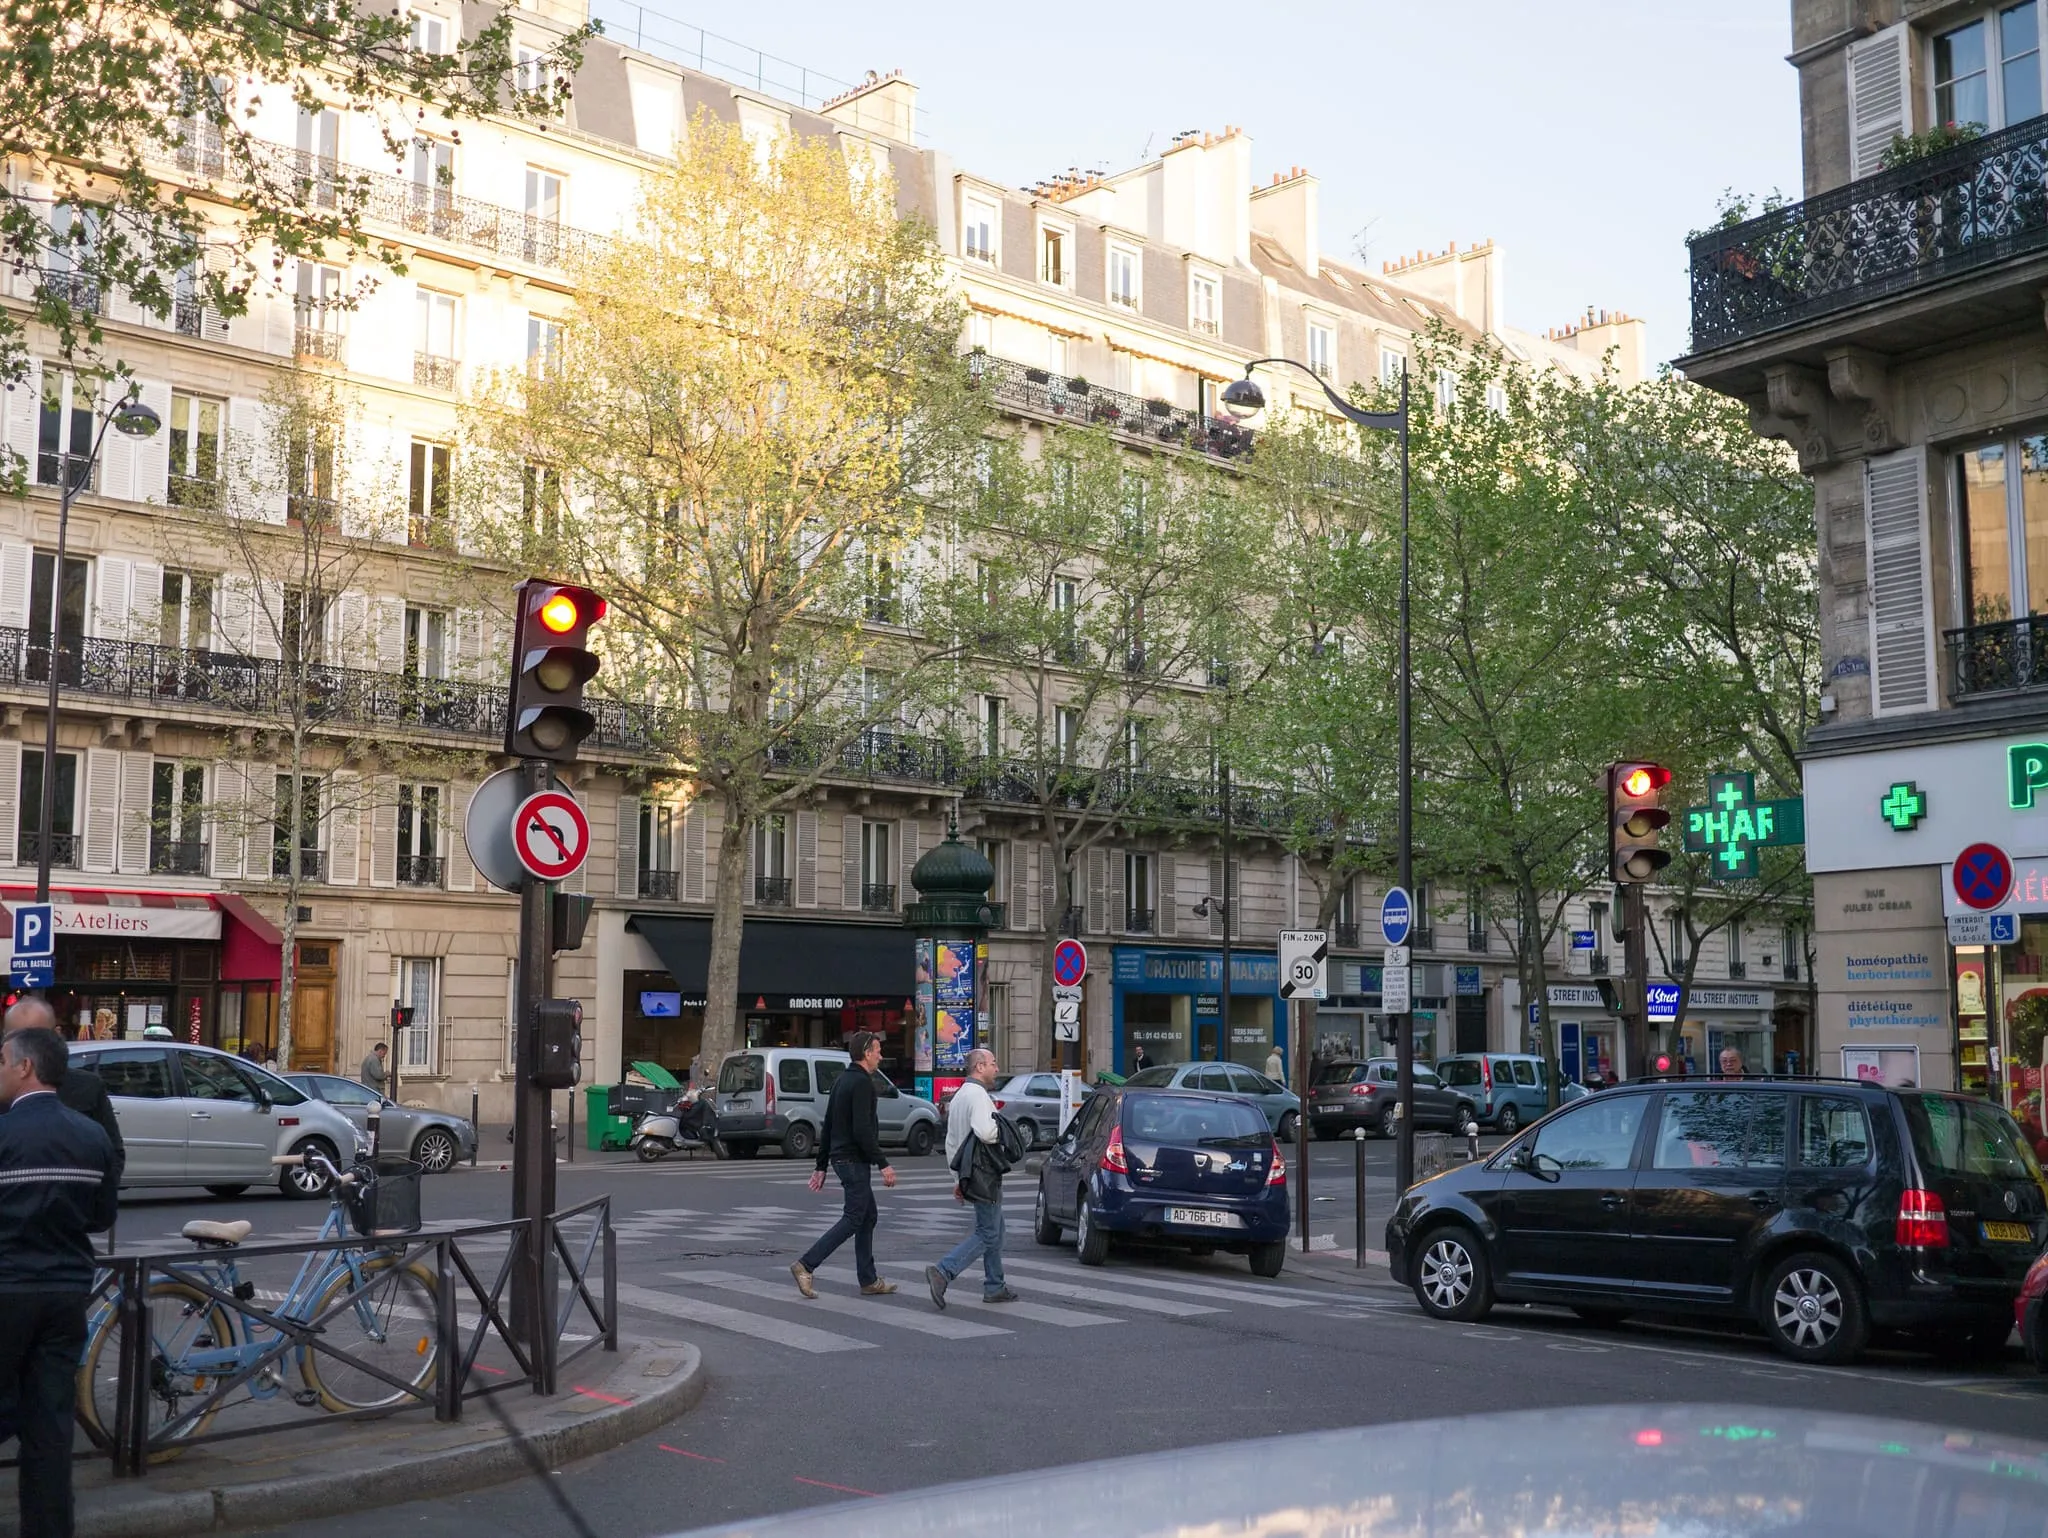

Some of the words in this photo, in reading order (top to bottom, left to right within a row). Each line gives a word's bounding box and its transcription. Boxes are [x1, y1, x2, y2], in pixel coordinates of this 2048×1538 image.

[1954, 916, 1984, 924] INTERDIT
[23, 914, 42, 946] P
[1960, 925, 1978, 933] SAUF
[1283, 933, 1296, 941] FIN
[1303, 934, 1325, 942] ZONE
[30, 960, 52, 968] BASTILLE
[1846, 953, 1929, 967] homéopathie
[1295, 965, 1314, 980] 30
[1847, 968, 1933, 981] herboristerie
[1553, 989, 1580, 1001] STREET
[1654, 988, 1680, 1004] Street
[1689, 992, 1702, 1004] ALL
[1703, 992, 1727, 1005] STREET
[1728, 993, 1760, 1006] INSTITUTE
[789, 998, 823, 1009] AMORE
[824, 998, 844, 1009] MIO
[1648, 1005, 1674, 1014] NSTITUTE
[1847, 1000, 1913, 1014] diététique
[1848, 1013, 1939, 1028] phytothérapie
